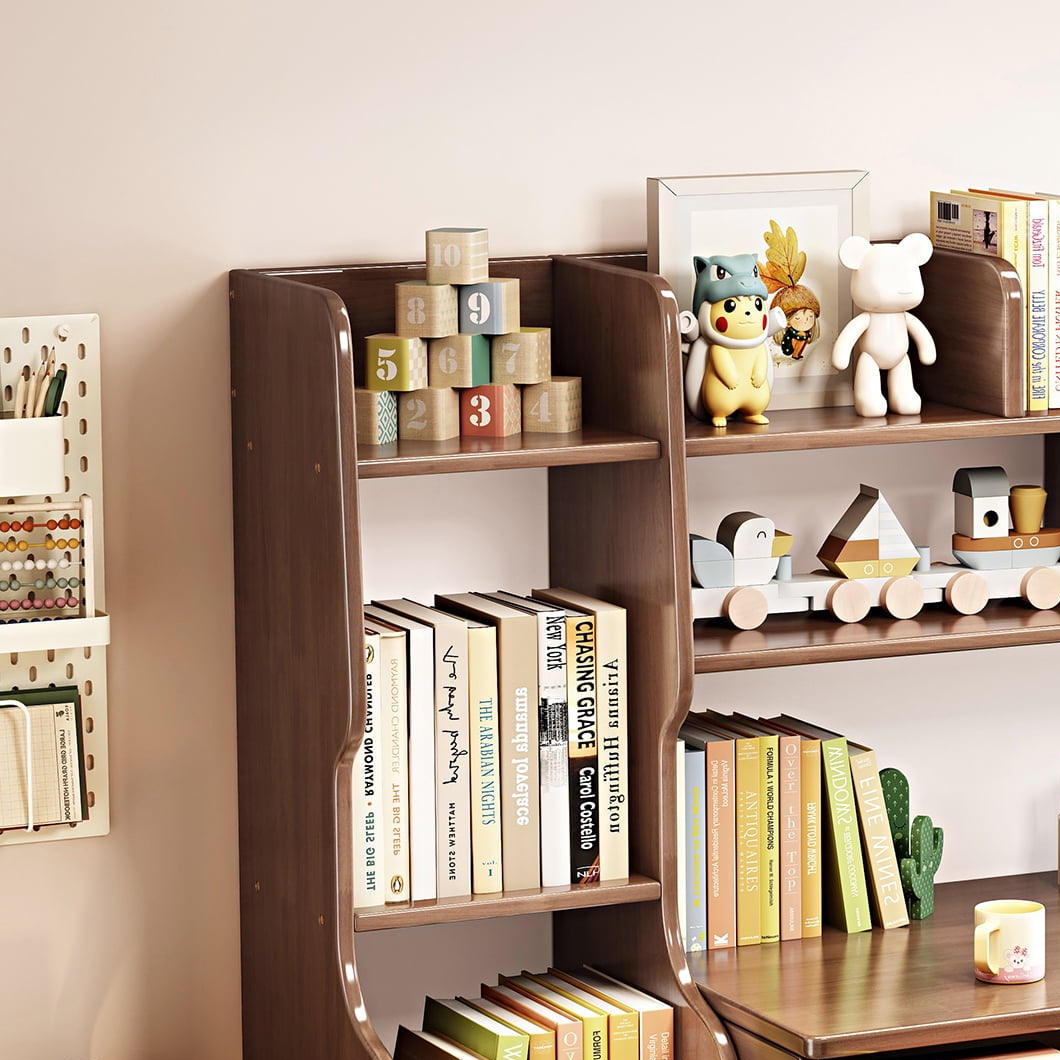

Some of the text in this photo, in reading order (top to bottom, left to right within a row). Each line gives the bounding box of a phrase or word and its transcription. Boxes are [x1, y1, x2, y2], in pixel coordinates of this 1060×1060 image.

[432, 243, 461, 267] 10
[406, 297, 426, 324] 8
[467, 292, 491, 325] 9
[376, 348, 398, 381] 5
[438, 347, 458, 374] 6
[502, 343, 521, 374] 7
[406, 398, 427, 430] 2
[469, 395, 491, 427] 3
[530, 391, 552, 423] 4
[546, 616, 566, 641] New
[547, 643, 567, 671] York
[575, 621, 596, 750] CHASING GRACE
[479, 697, 497, 826] THE ARABIAN NIGHTS
[579, 767, 597, 850] Carol Costello
[766, 785, 774, 810] WORLD
[745, 791, 759, 893] ANTIQUAIRES
[766, 811, 774, 850] CHAMPIONS
[661, 1031, 670, 1053] Detail
